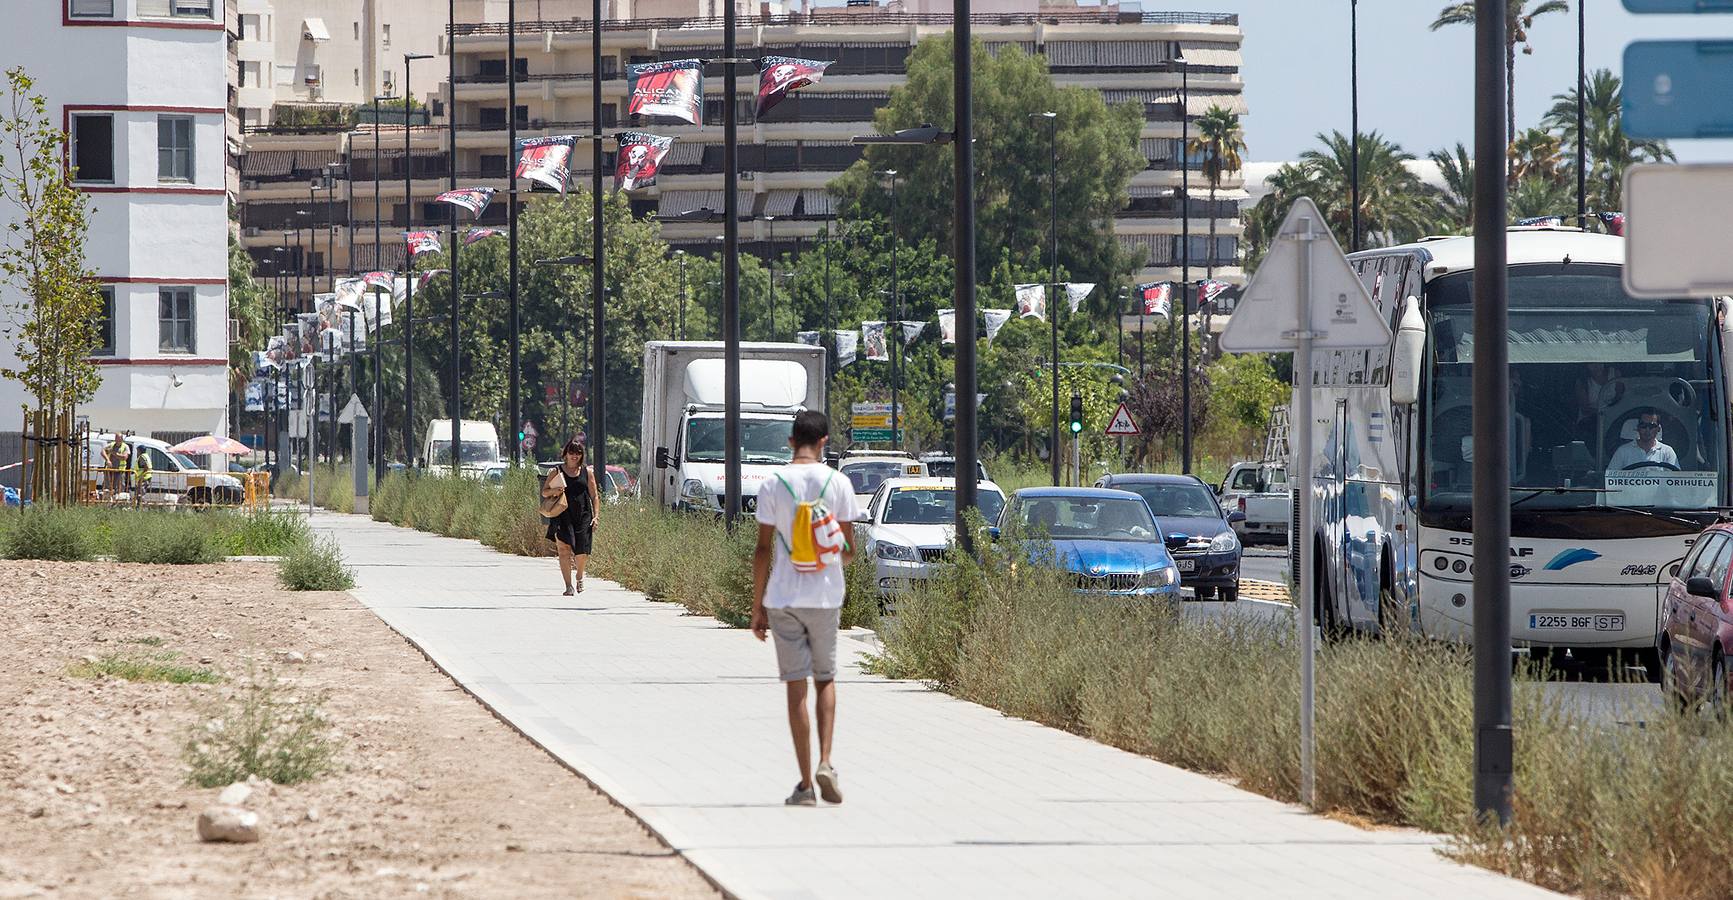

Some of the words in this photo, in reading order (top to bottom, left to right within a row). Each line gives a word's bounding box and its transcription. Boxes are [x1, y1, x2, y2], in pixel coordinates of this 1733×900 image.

[633, 87, 701, 102] ALICANE
[1608, 478, 1660, 486] DIRECCION
[1666, 479, 1715, 487] ORIHUELA
[1539, 616, 1567, 628] 2255
[1571, 617, 1592, 628] BGF
[1599, 617, 1620, 629] SP
